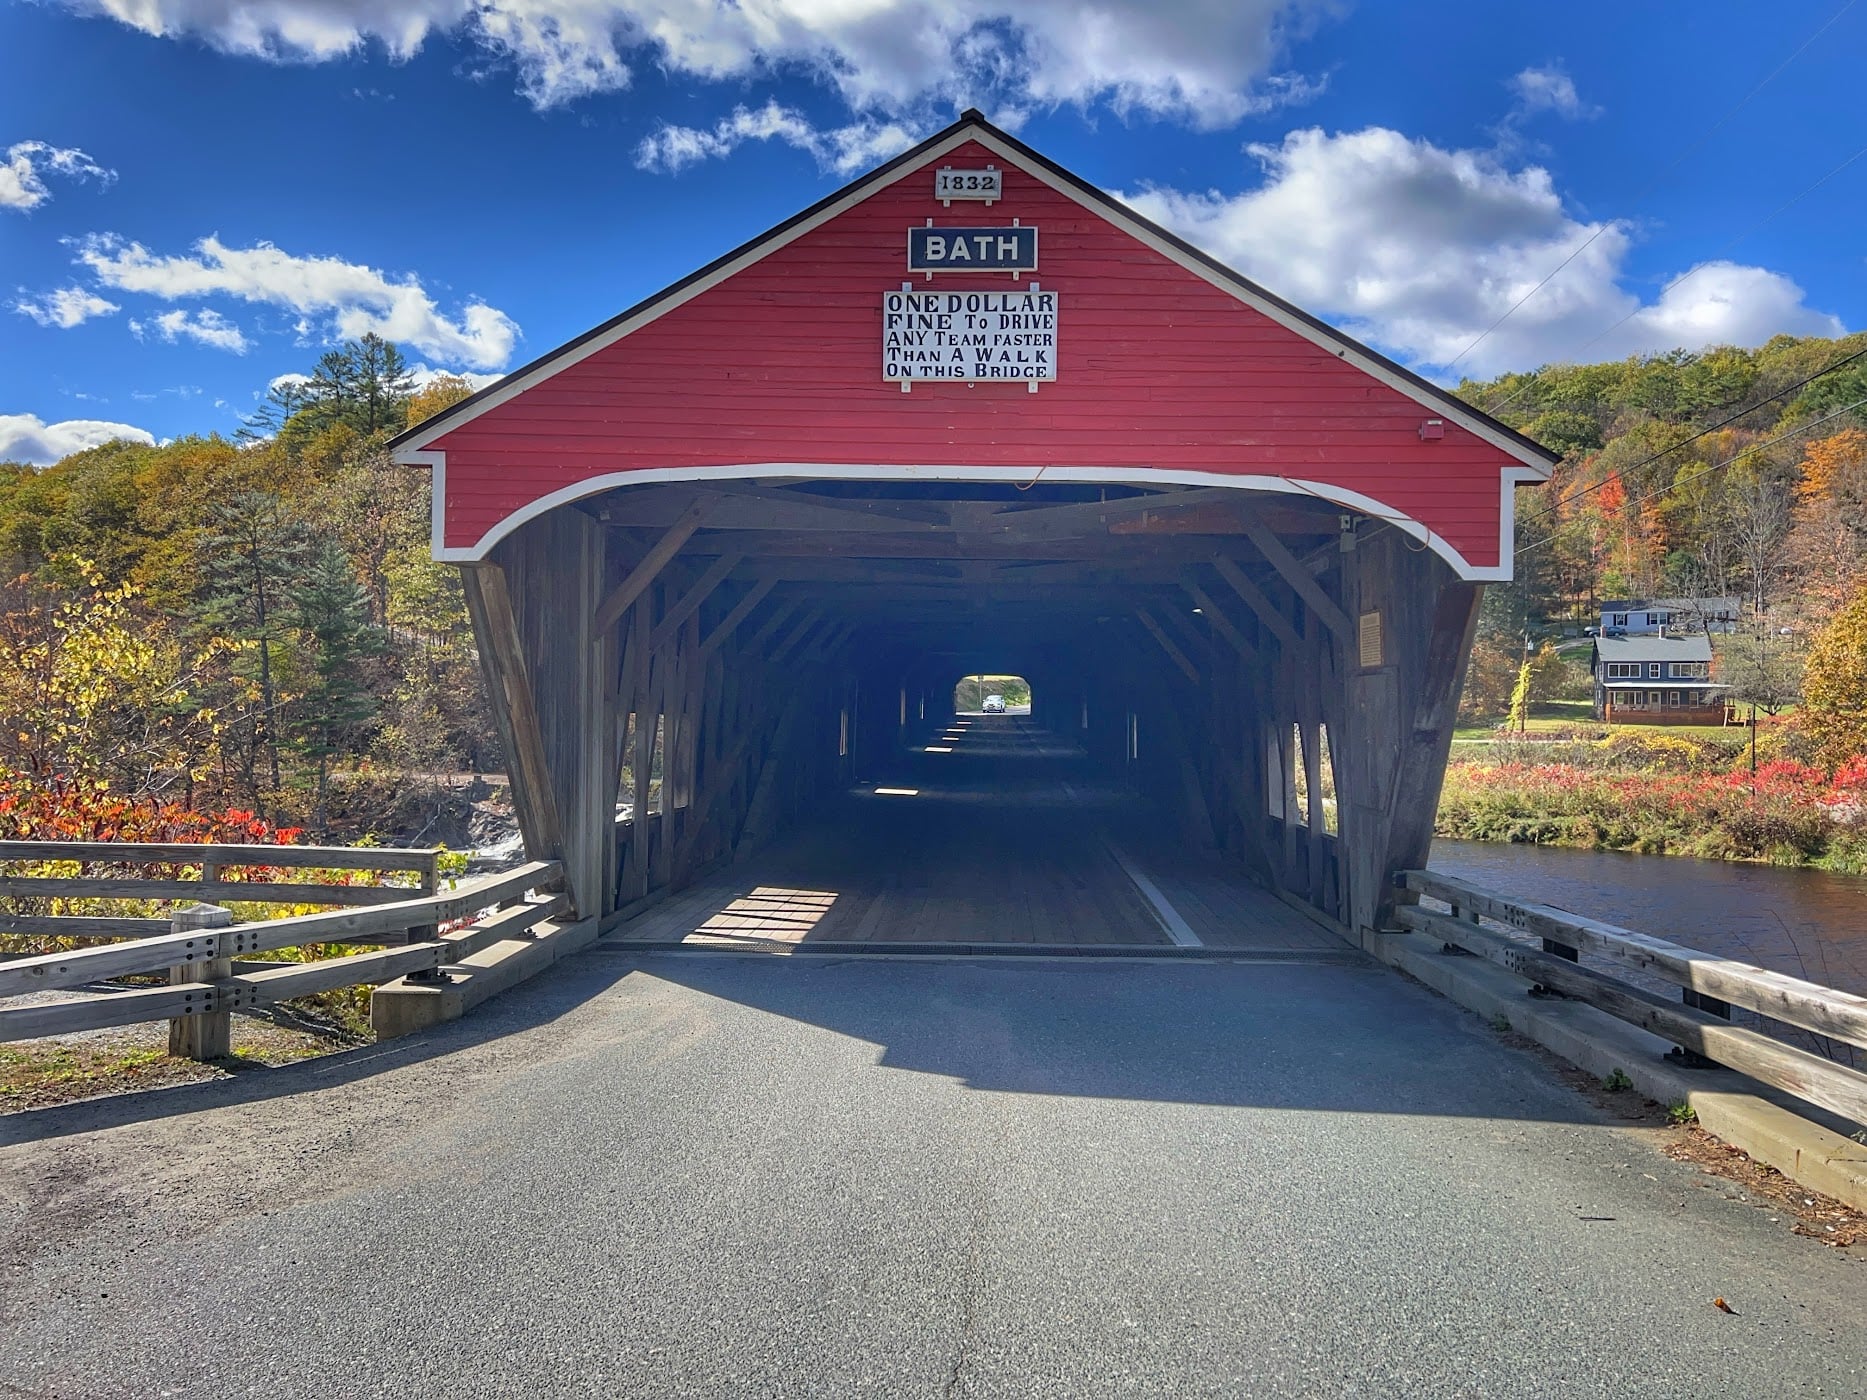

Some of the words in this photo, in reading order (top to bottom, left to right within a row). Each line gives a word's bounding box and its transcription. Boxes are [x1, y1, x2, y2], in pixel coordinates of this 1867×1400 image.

[942, 175, 995, 190] 1832
[926, 236, 1018, 260] BATH
[888, 295, 939, 313] ONE
[947, 294, 1053, 313] DOLLAR
[887, 314, 952, 329] FINE
[1000, 314, 1053, 329] DRIVE
[887, 330, 928, 346] ANY
[935, 331, 986, 346] TEAM
[994, 334, 1053, 346] FASTER
[887, 347, 941, 362] THAN
[951, 348, 964, 362] A
[976, 348, 1048, 363] WALK
[886, 363, 912, 377] ON
[920, 365, 965, 377] THIS
[975, 363, 1047, 378] BRIDGE
